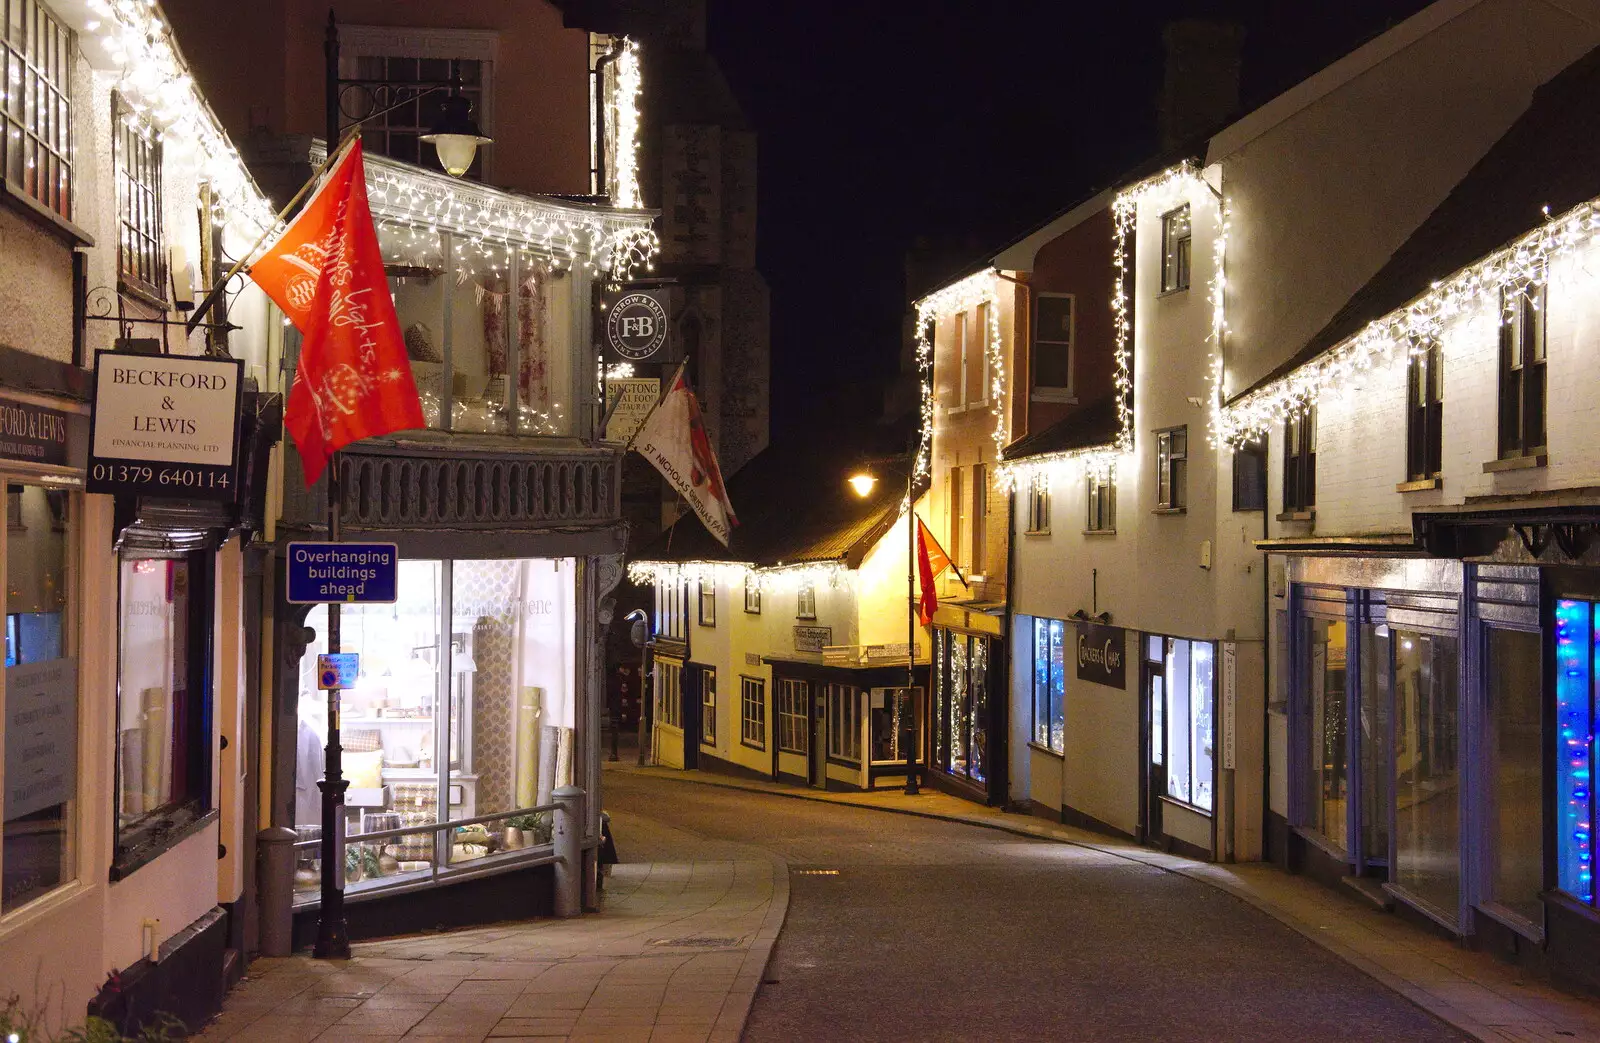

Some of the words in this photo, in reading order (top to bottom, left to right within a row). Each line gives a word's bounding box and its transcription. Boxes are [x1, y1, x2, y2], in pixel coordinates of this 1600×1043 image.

[610, 296, 639, 323] FARROW
[649, 301, 664, 322] BALL
[334, 287, 386, 363] Lights
[622, 316, 654, 337] F&B
[612, 335, 630, 355] PAINT
[643, 334, 663, 355] PAPER
[112, 368, 227, 391] BECKFORD
[161, 396, 175, 411] &
[608, 395, 631, 403] TAI
[29, 412, 36, 439] &
[38, 413, 65, 444] LEWIS
[133, 416, 196, 435] LEWIS
[112, 439, 155, 449] FINANCIAL
[157, 442, 200, 452] PLANNING
[93, 463, 153, 483] 01379
[159, 468, 230, 489] 640114
[644, 443, 656, 454] ST
[656, 453, 690, 492] NICHOLAS
[296, 549, 389, 565] Overhanging
[308, 566, 376, 580] buildings
[320, 582, 364, 595] ahead
